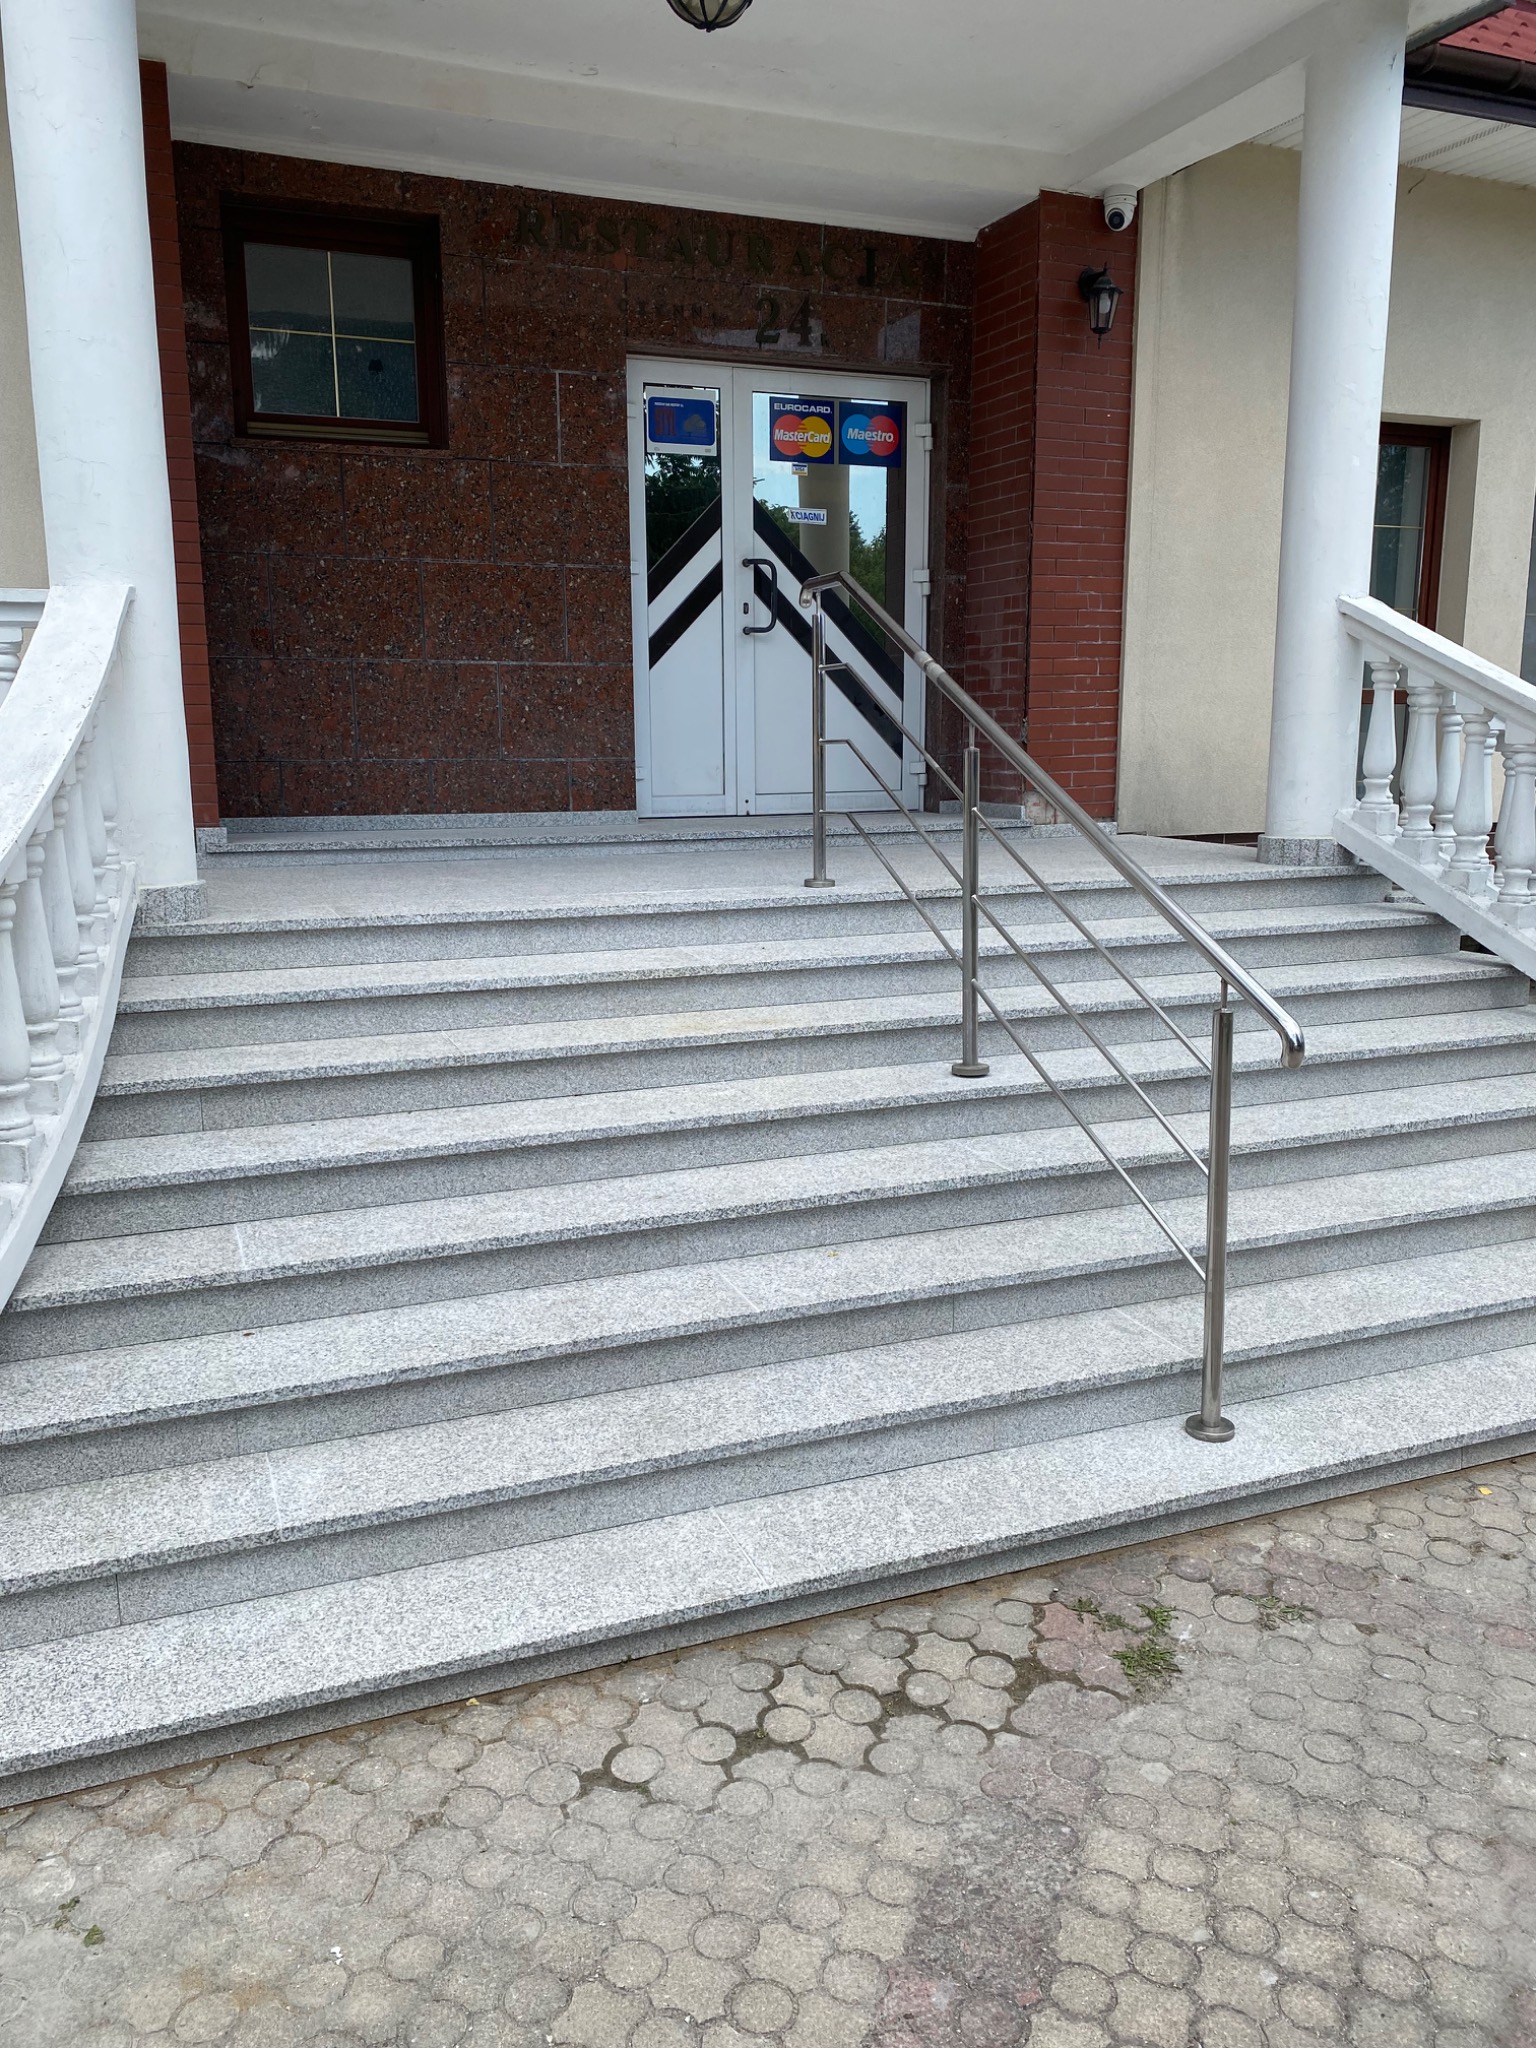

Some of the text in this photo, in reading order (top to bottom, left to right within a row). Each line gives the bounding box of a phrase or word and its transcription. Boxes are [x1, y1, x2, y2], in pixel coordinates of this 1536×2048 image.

[517, 206, 917, 287] RESTAURACJA
[755, 293, 813, 346] 24
[774, 403, 831, 414] EUROCARD
[774, 429, 831, 444] MasterCard
[847, 428, 894, 443] Maestro
